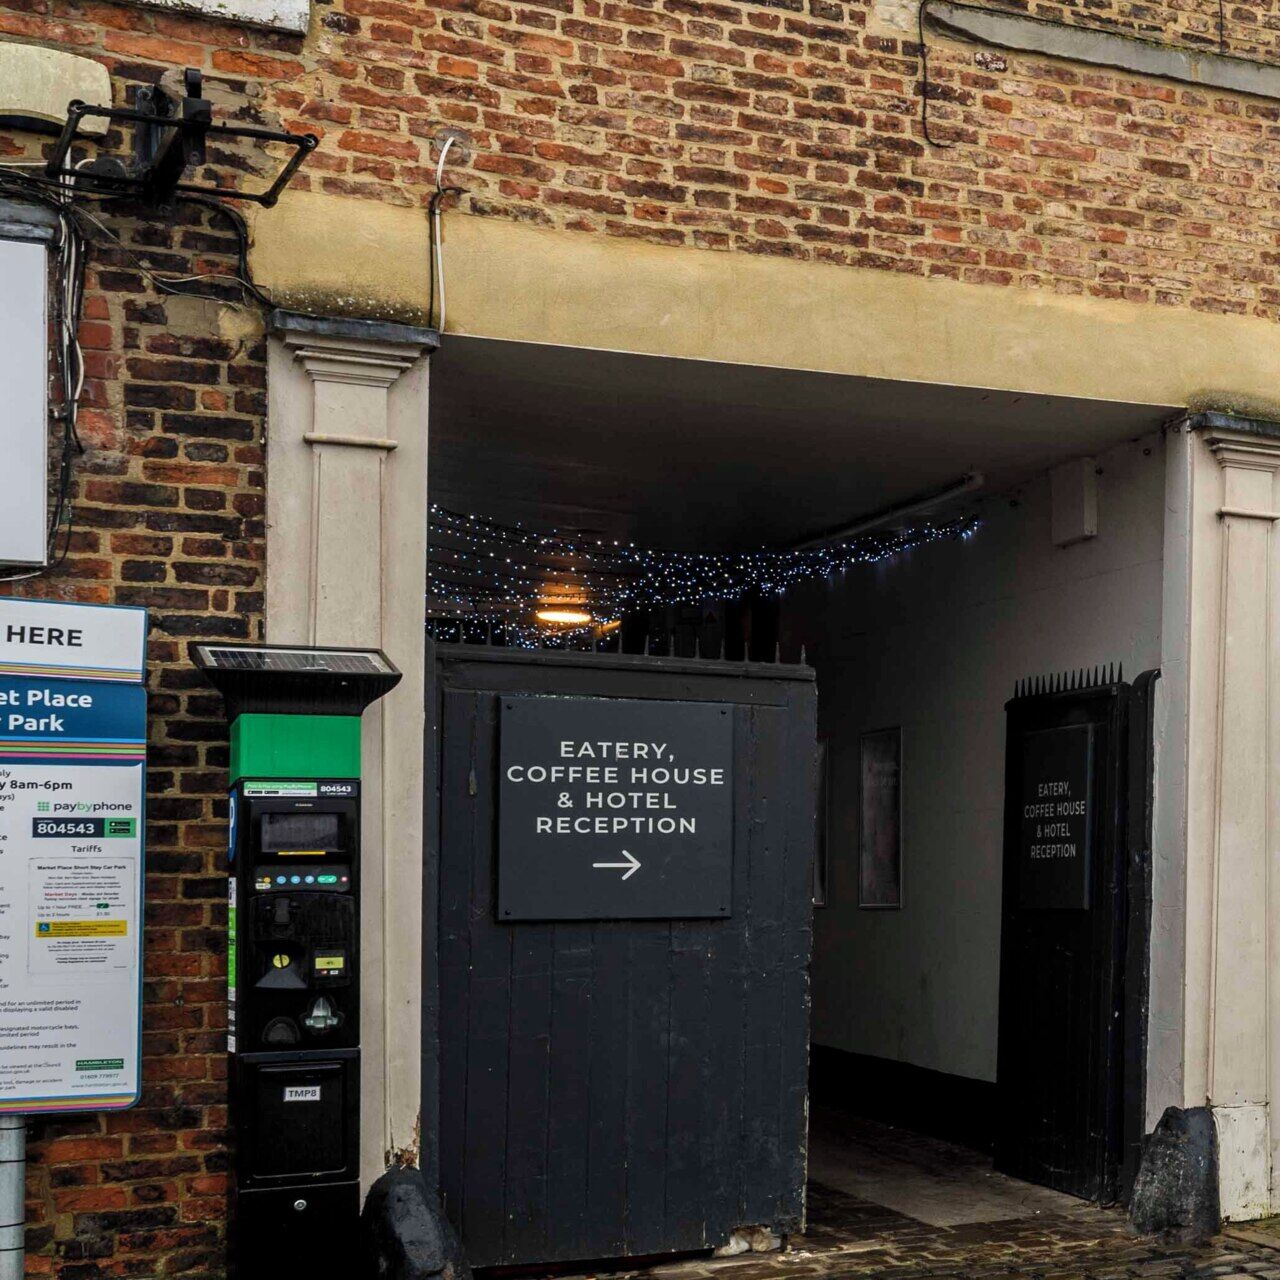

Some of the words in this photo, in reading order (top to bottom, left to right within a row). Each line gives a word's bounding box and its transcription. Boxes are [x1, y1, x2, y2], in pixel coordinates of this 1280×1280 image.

[7, 625, 82, 646] HERE
[28, 689, 92, 707] Place
[9, 714, 64, 731] Park
[560, 741, 675, 762] EATERY,
[506, 766, 618, 783] COFFEE
[631, 768, 724, 784] HOUSE
[10, 780, 72, 791] 8am-6pm
[1039, 782, 1071, 796] EATERY,
[54, 802, 132, 812] paybyphone
[557, 792, 573, 808] &
[587, 792, 676, 808] HOTEL
[1024, 803, 1054, 818] COFFEE
[1057, 801, 1085, 815] HOUSE
[37, 823, 94, 834] 804543
[537, 817, 696, 834] RECEPTION
[1037, 825, 1041, 837] &
[1045, 823, 1070, 837] HOTEL
[1031, 844, 1076, 858] RECEPTION
[288, 1089, 317, 1097] TMP8
